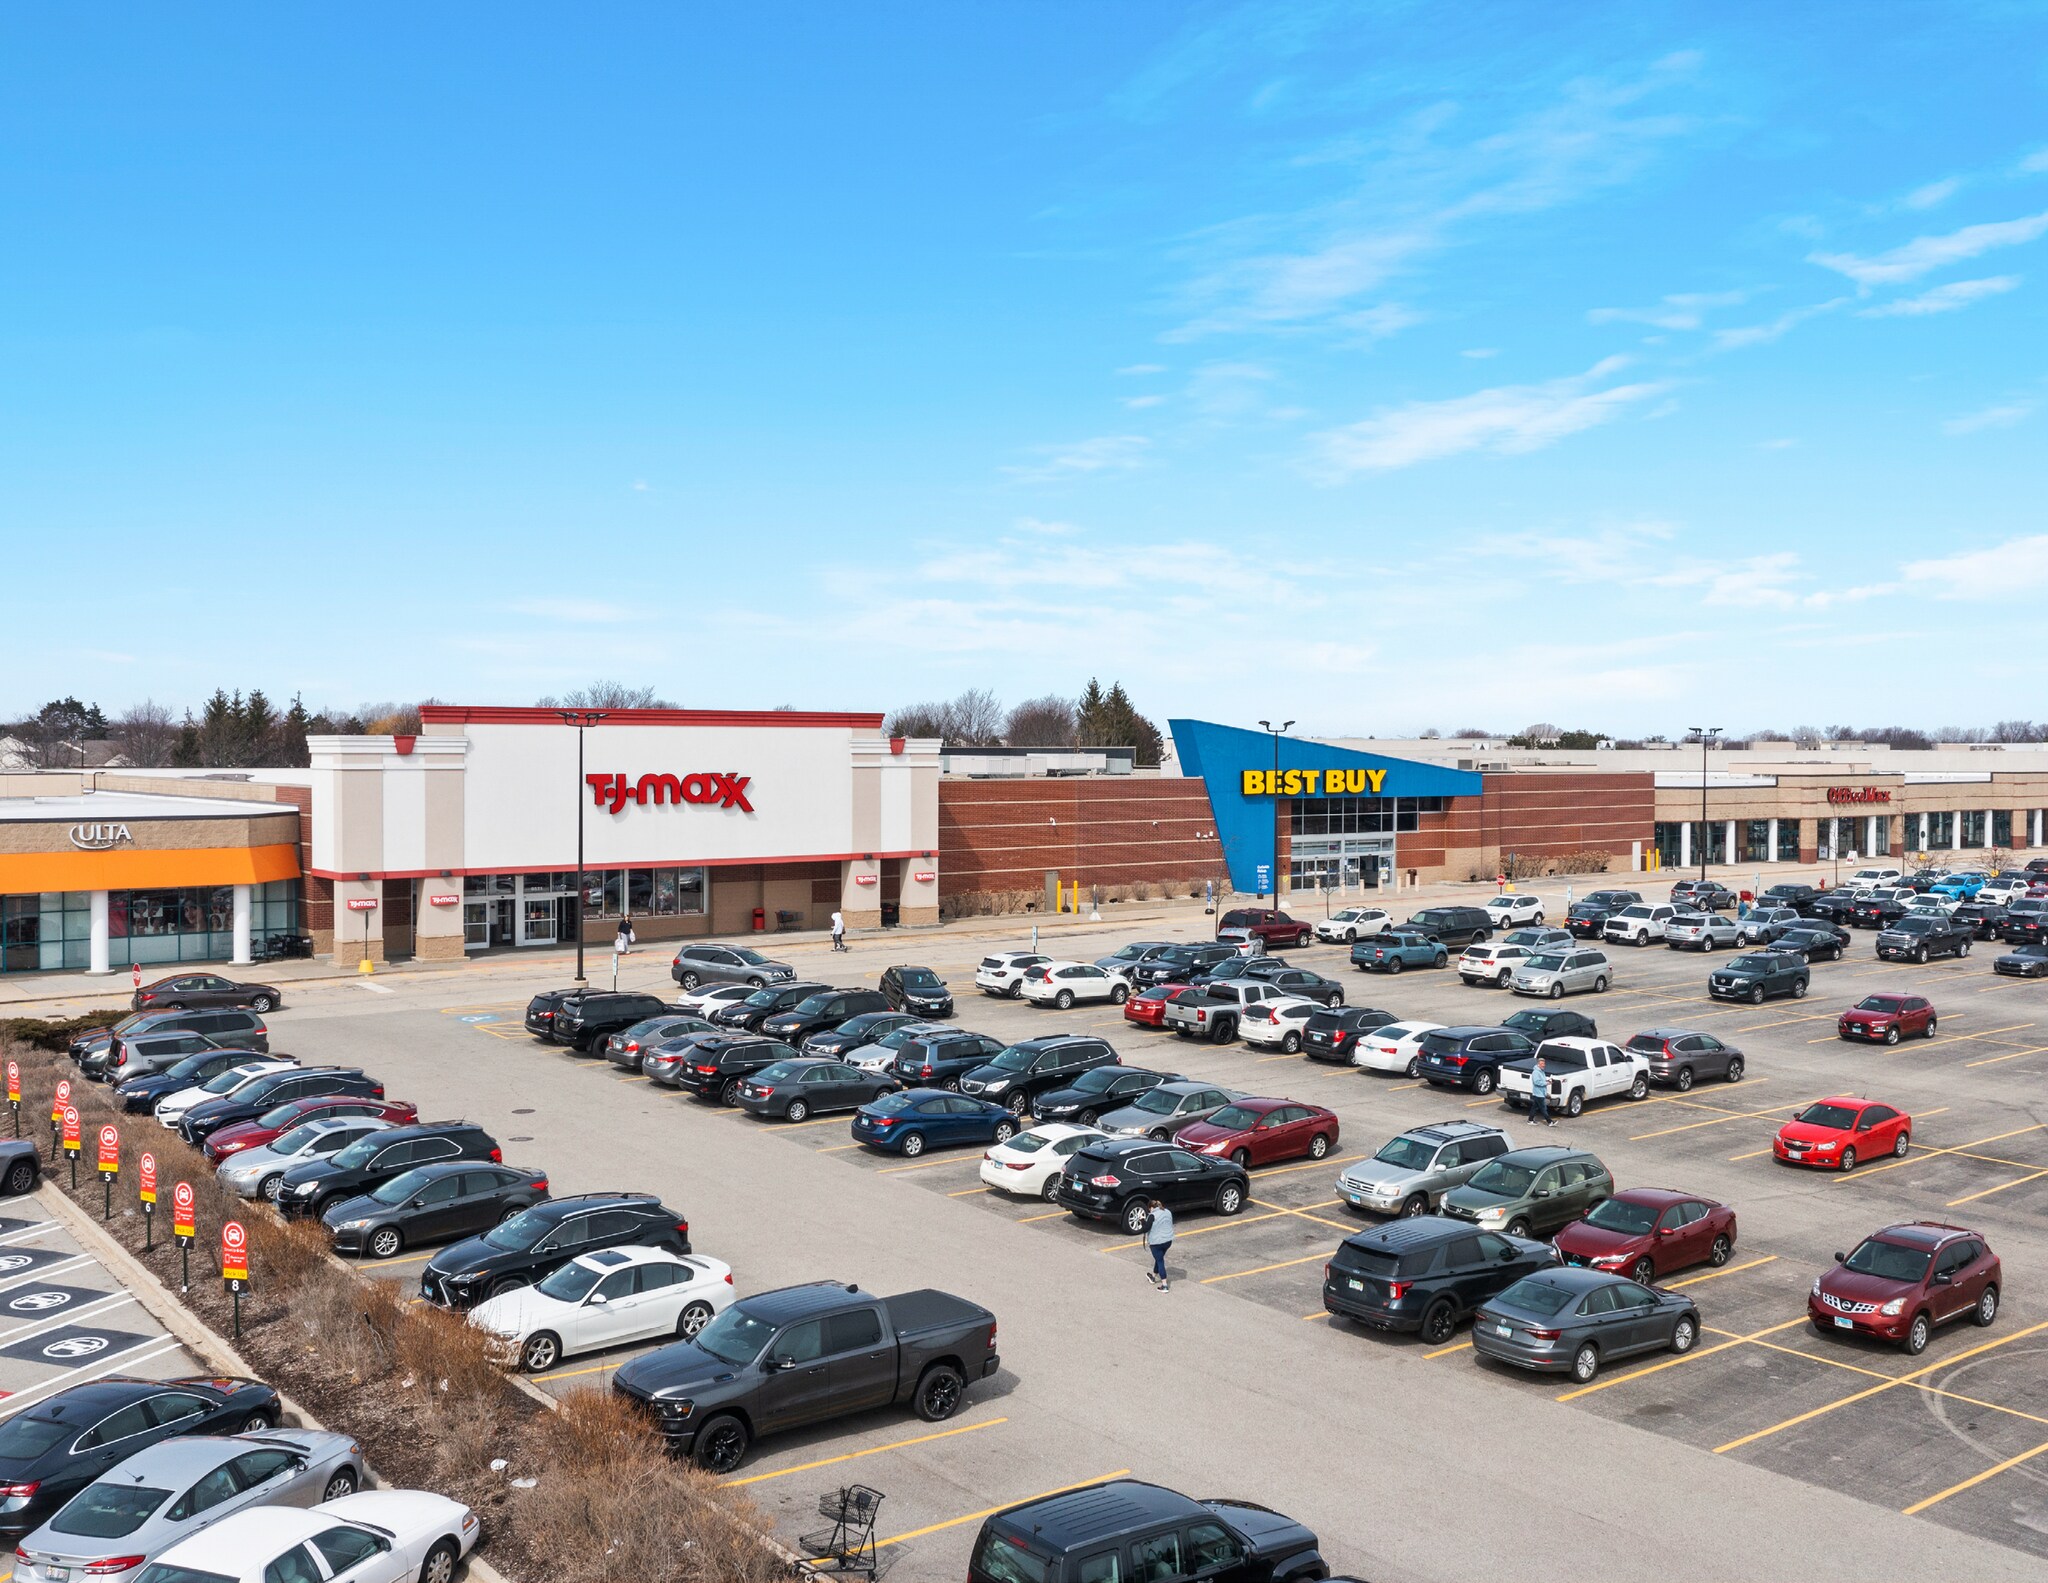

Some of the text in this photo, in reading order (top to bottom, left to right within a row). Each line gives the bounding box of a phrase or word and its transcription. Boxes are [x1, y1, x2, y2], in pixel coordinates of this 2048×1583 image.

[1242, 769, 1388, 795] BEST BUY
[1827, 786, 1891, 804] OfficeMax
[78, 824, 132, 841] ULTA
[13, 1101, 18, 1110] 2
[69, 1150, 76, 1159] 4
[104, 1172, 111, 1182] 5
[145, 1202, 151, 1213] 6
[181, 1236, 188, 1247] 7
[231, 1280, 239, 1291] 8
